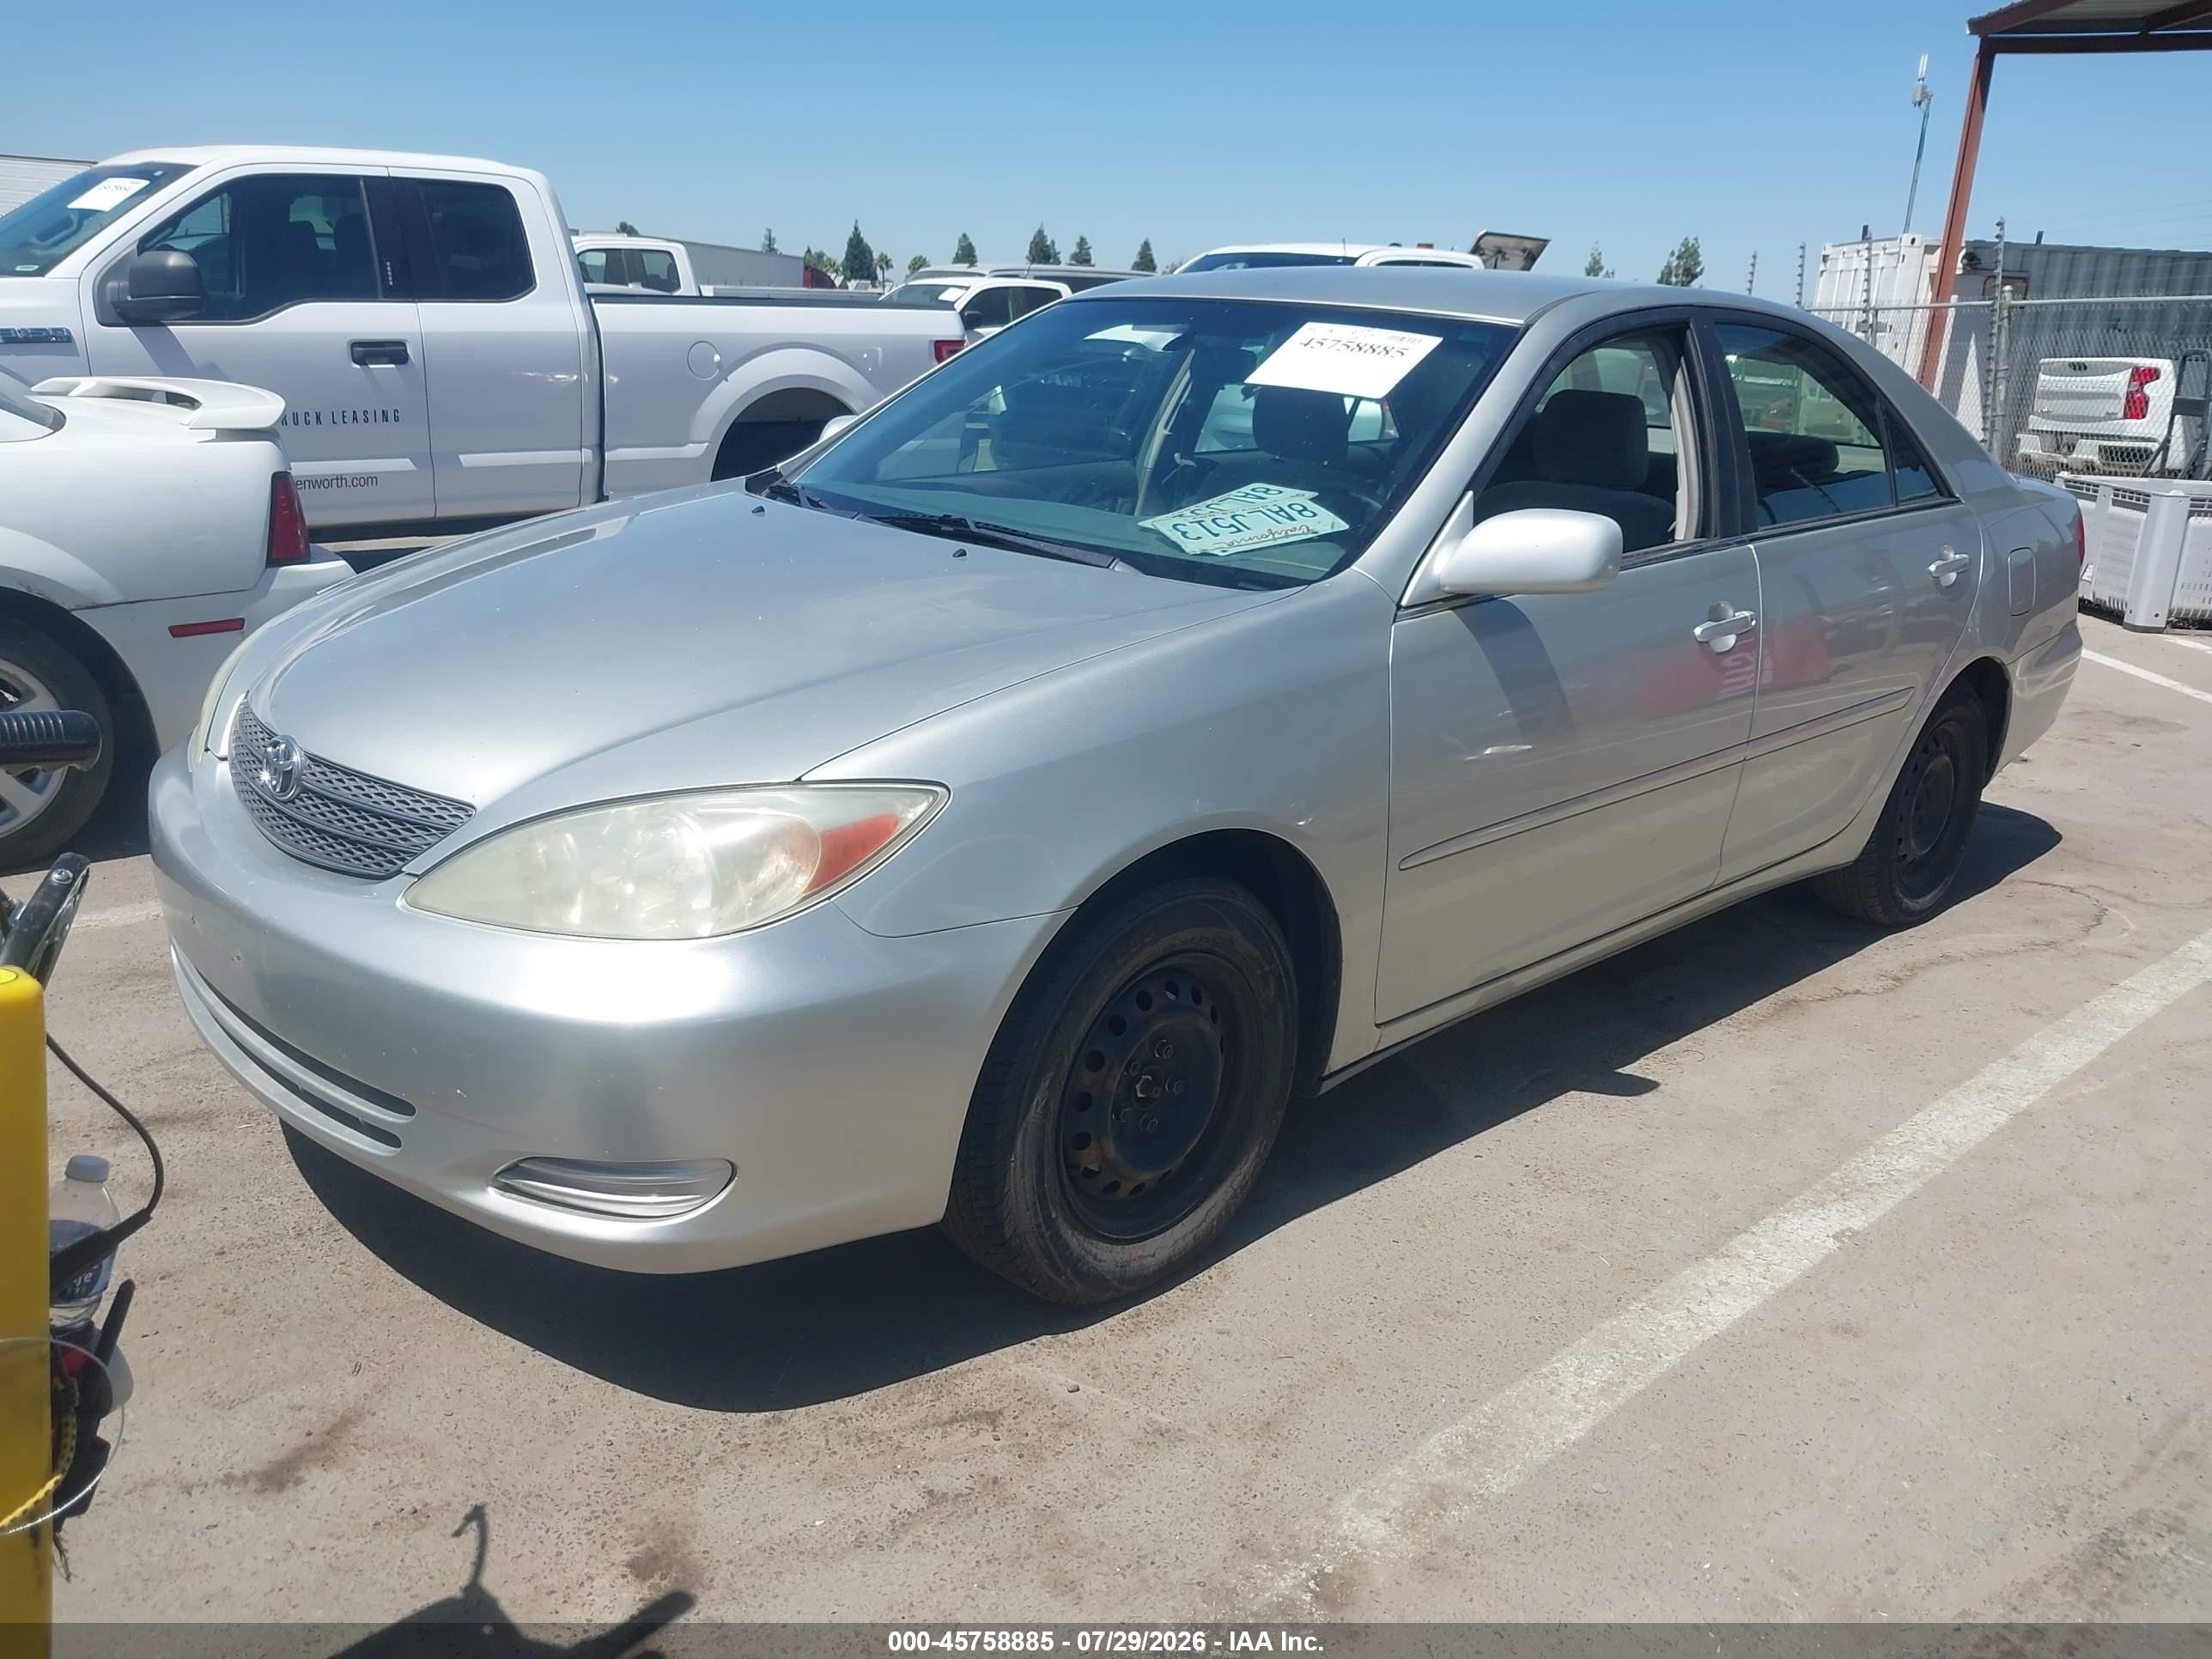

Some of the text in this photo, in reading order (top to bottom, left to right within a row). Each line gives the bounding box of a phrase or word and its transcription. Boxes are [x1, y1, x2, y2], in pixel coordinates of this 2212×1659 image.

[1300, 337, 1409, 358] 45758885
[331, 409, 400, 425] LEASING
[1171, 502, 1318, 541] 8ALJ513
[1212, 525, 1314, 548] California
